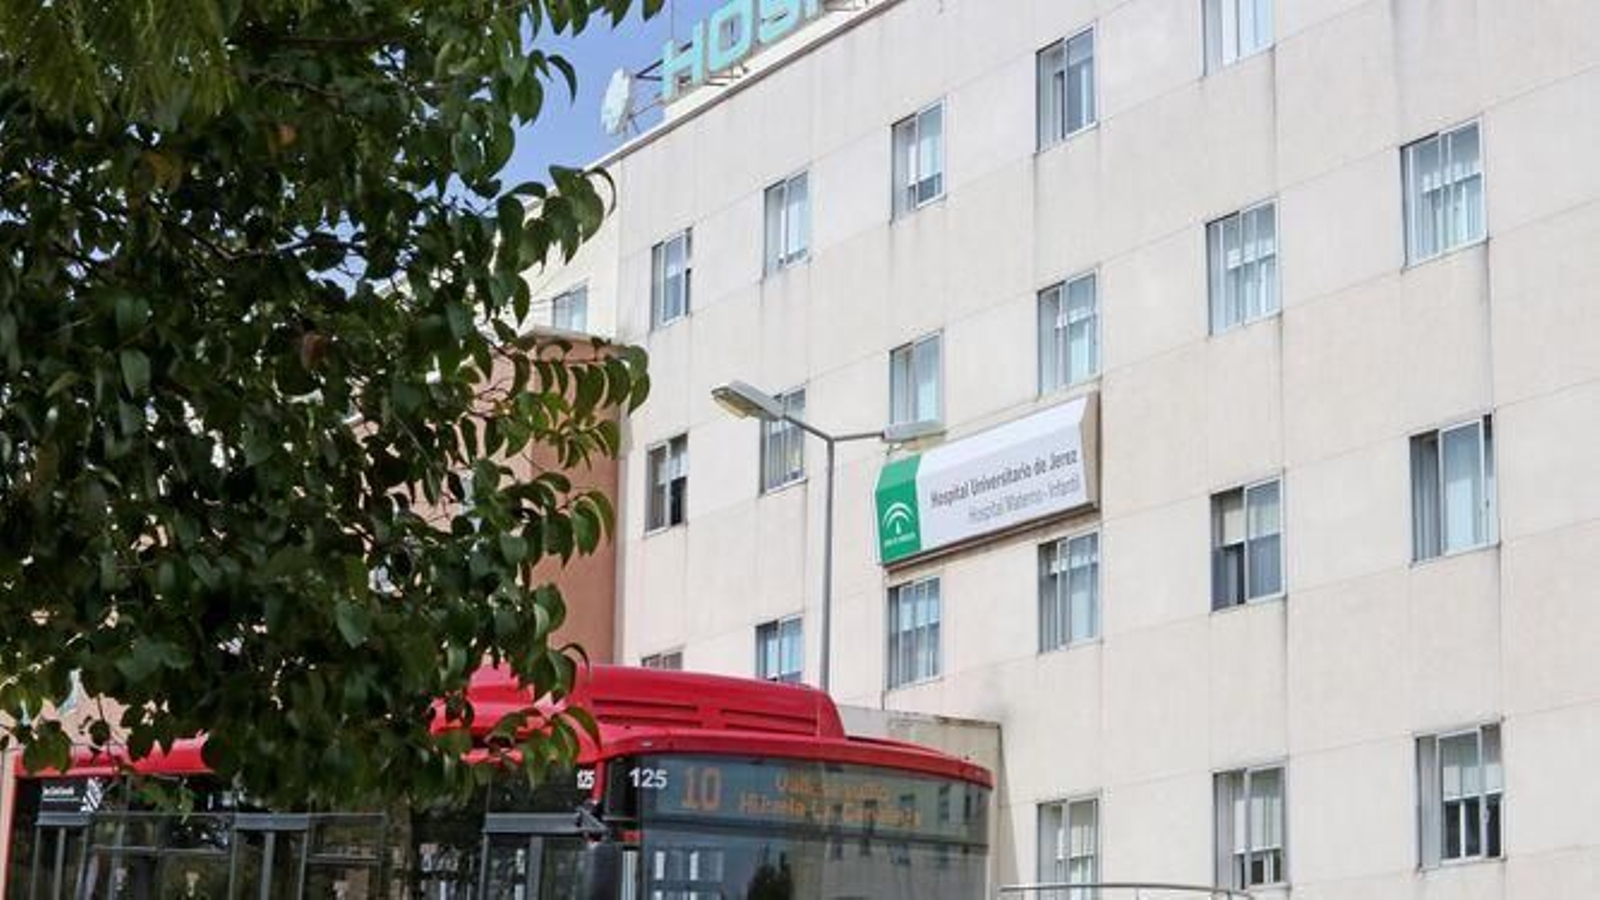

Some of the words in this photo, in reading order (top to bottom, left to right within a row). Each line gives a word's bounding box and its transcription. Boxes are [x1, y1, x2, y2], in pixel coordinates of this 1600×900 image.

[931, 482, 969, 507] Hospital
[969, 463, 1031, 496] Universitario
[1034, 457, 1046, 475] de
[1049, 450, 1078, 470] Jerez
[576, 769, 595, 789] 125
[629, 767, 668, 789] 125
[682, 767, 720, 811] 10
